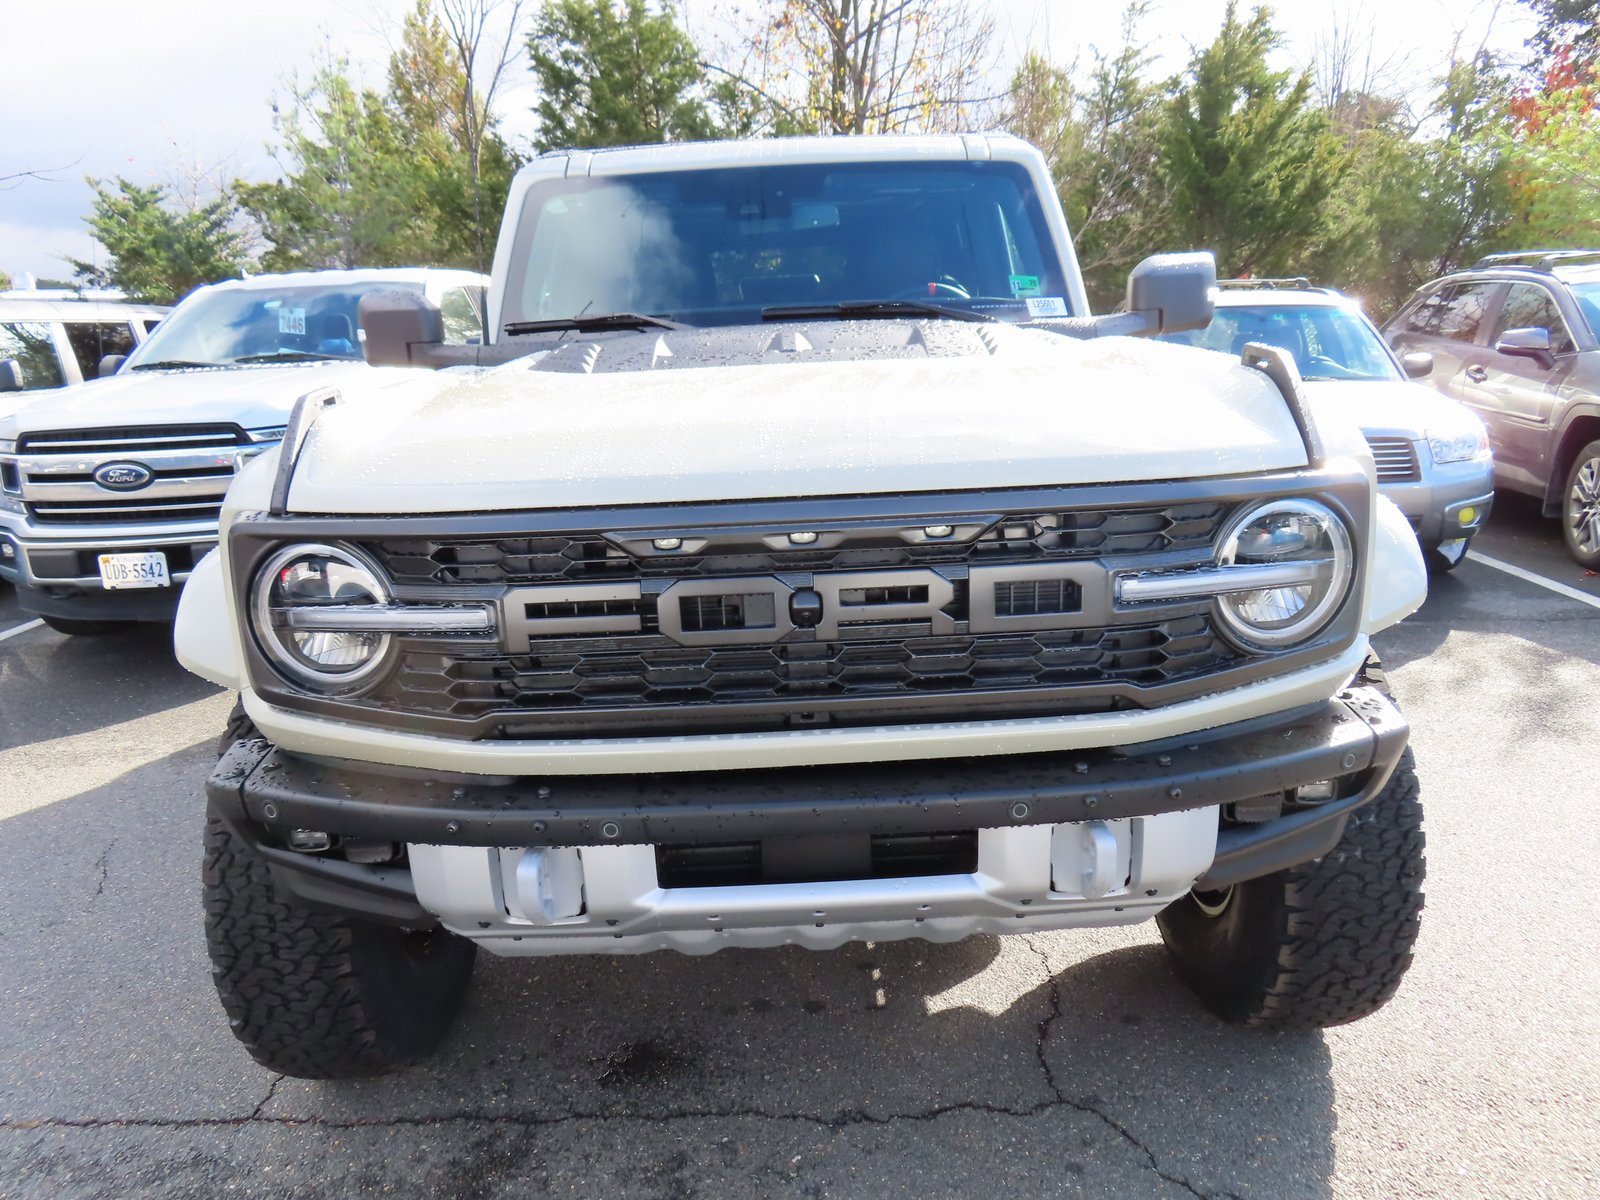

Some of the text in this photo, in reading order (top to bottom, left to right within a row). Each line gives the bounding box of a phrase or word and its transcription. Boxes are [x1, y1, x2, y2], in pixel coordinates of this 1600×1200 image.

[280, 315, 305, 333] 7446
[108, 470, 135, 482] Ford
[105, 562, 163, 579] UDB-5542
[503, 560, 1113, 655] FORD
